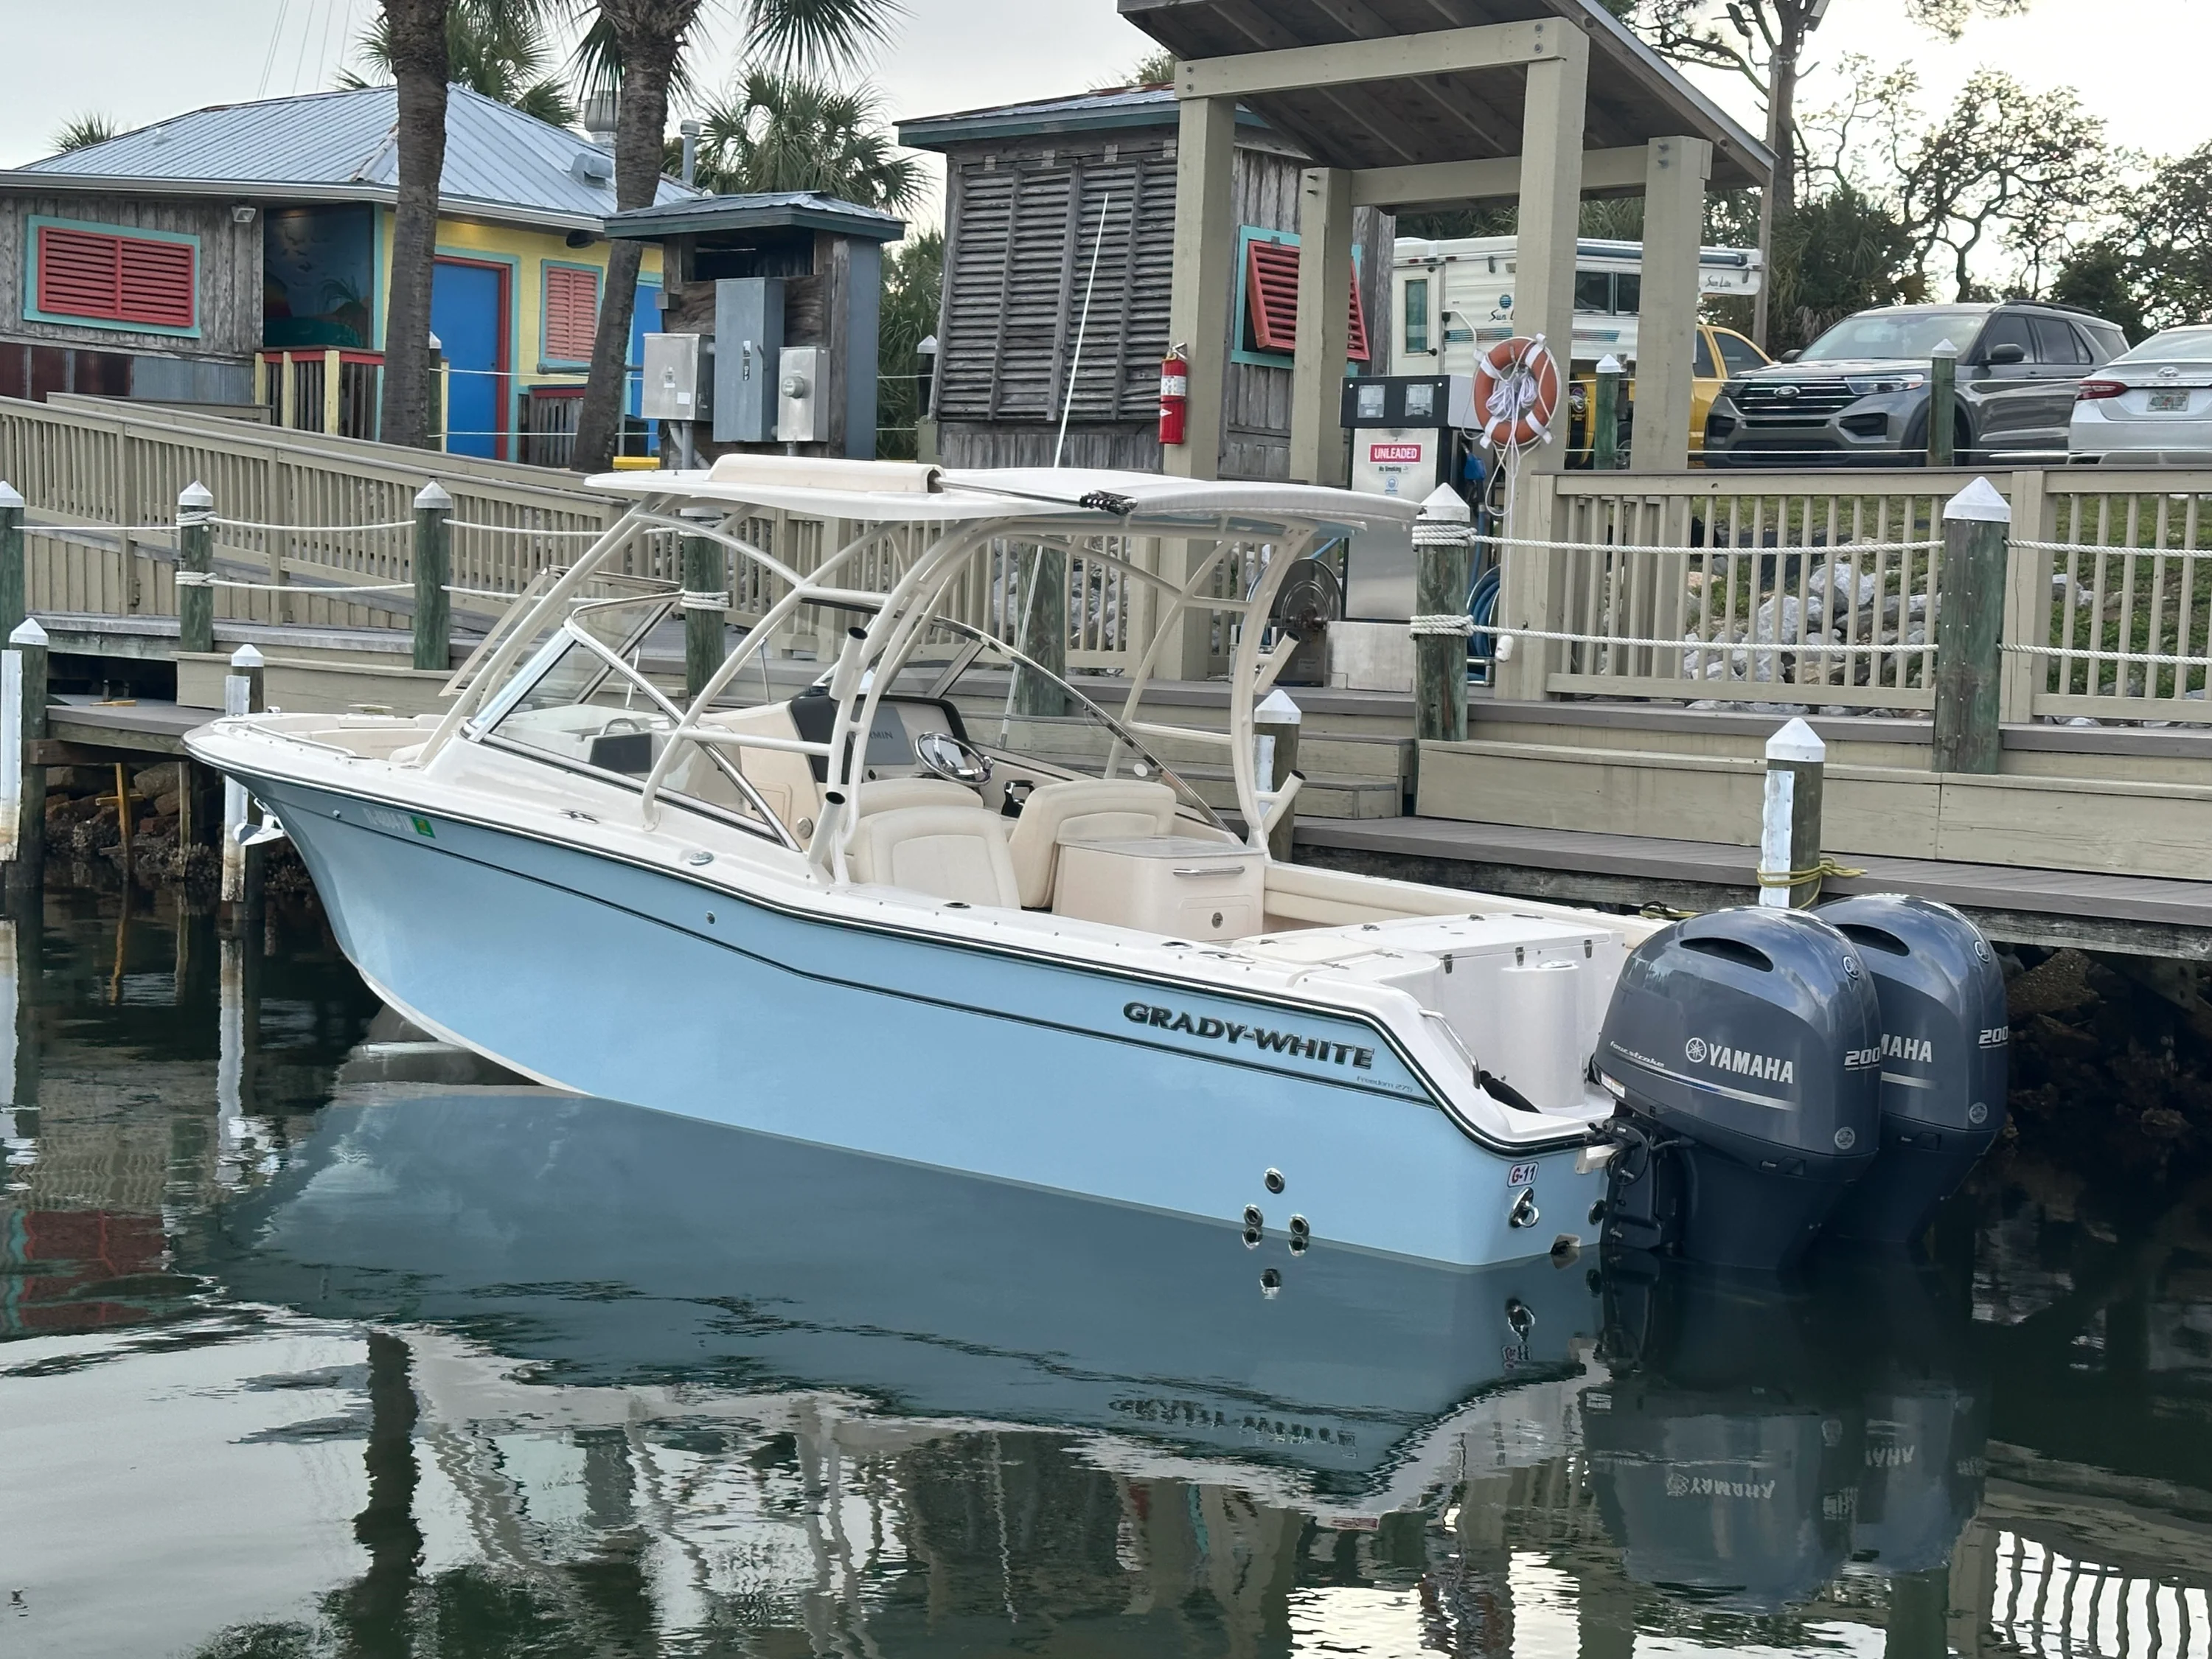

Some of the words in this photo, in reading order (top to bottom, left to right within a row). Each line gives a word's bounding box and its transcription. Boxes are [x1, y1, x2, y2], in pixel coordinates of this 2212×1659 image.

[1374, 447, 1417, 459] UNLEADED
[1123, 1001, 1375, 1069] GRADY-WHITE
[1978, 1025, 2008, 1044] 200
[1844, 1046, 1880, 1065] 200
[1881, 1033, 1932, 1063] MAHA
[1709, 1043, 1793, 1084] YAMAHA
